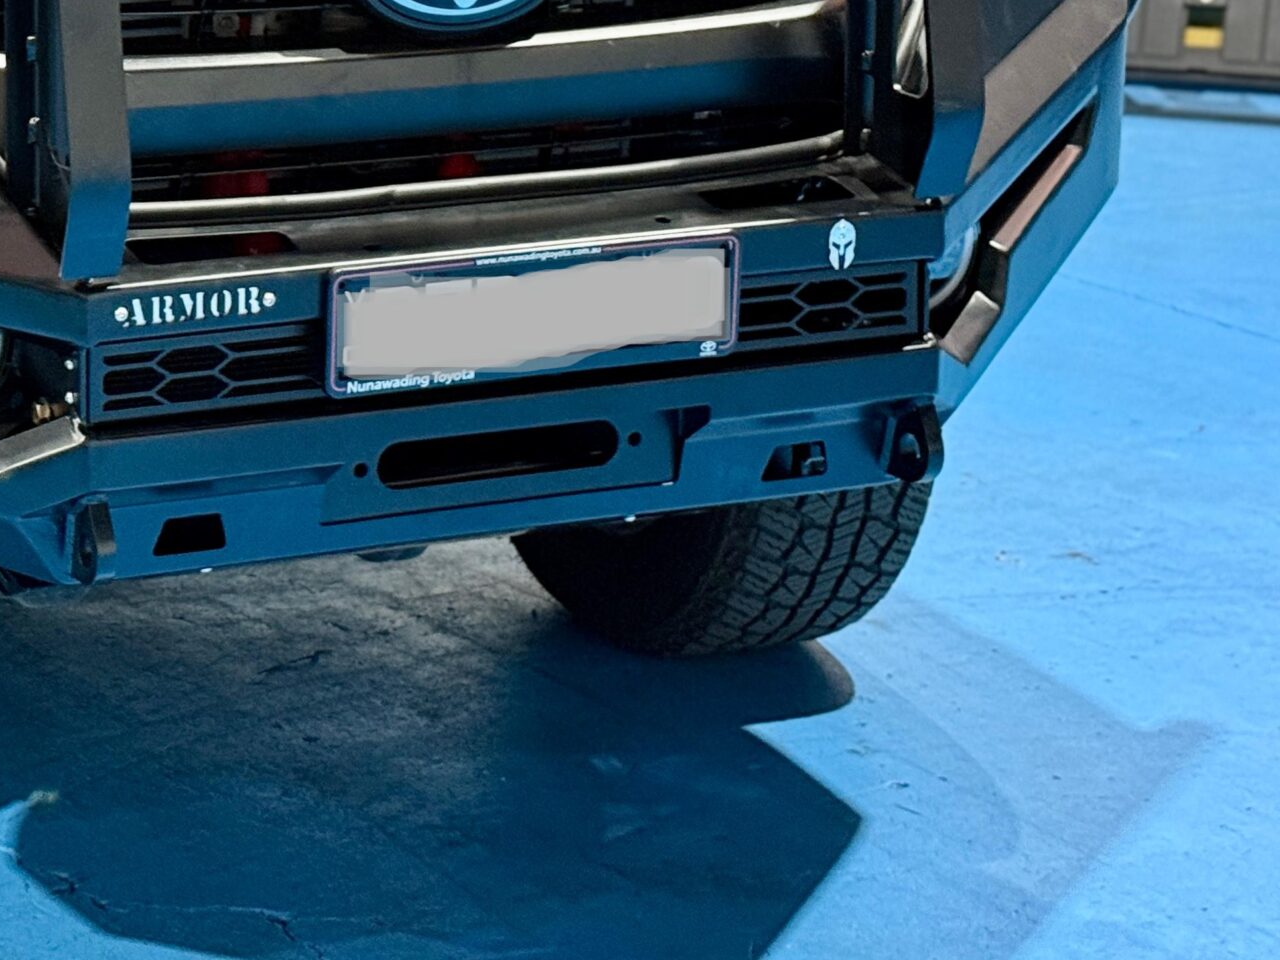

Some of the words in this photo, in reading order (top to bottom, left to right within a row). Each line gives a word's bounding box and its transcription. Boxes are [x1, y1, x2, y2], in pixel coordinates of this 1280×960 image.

[475, 246, 602, 266] www.nunawadingtoyota.com.au
[122, 286, 261, 328] ARMOR
[346, 373, 430, 394] Nunawading
[431, 368, 476, 385] Toyota
